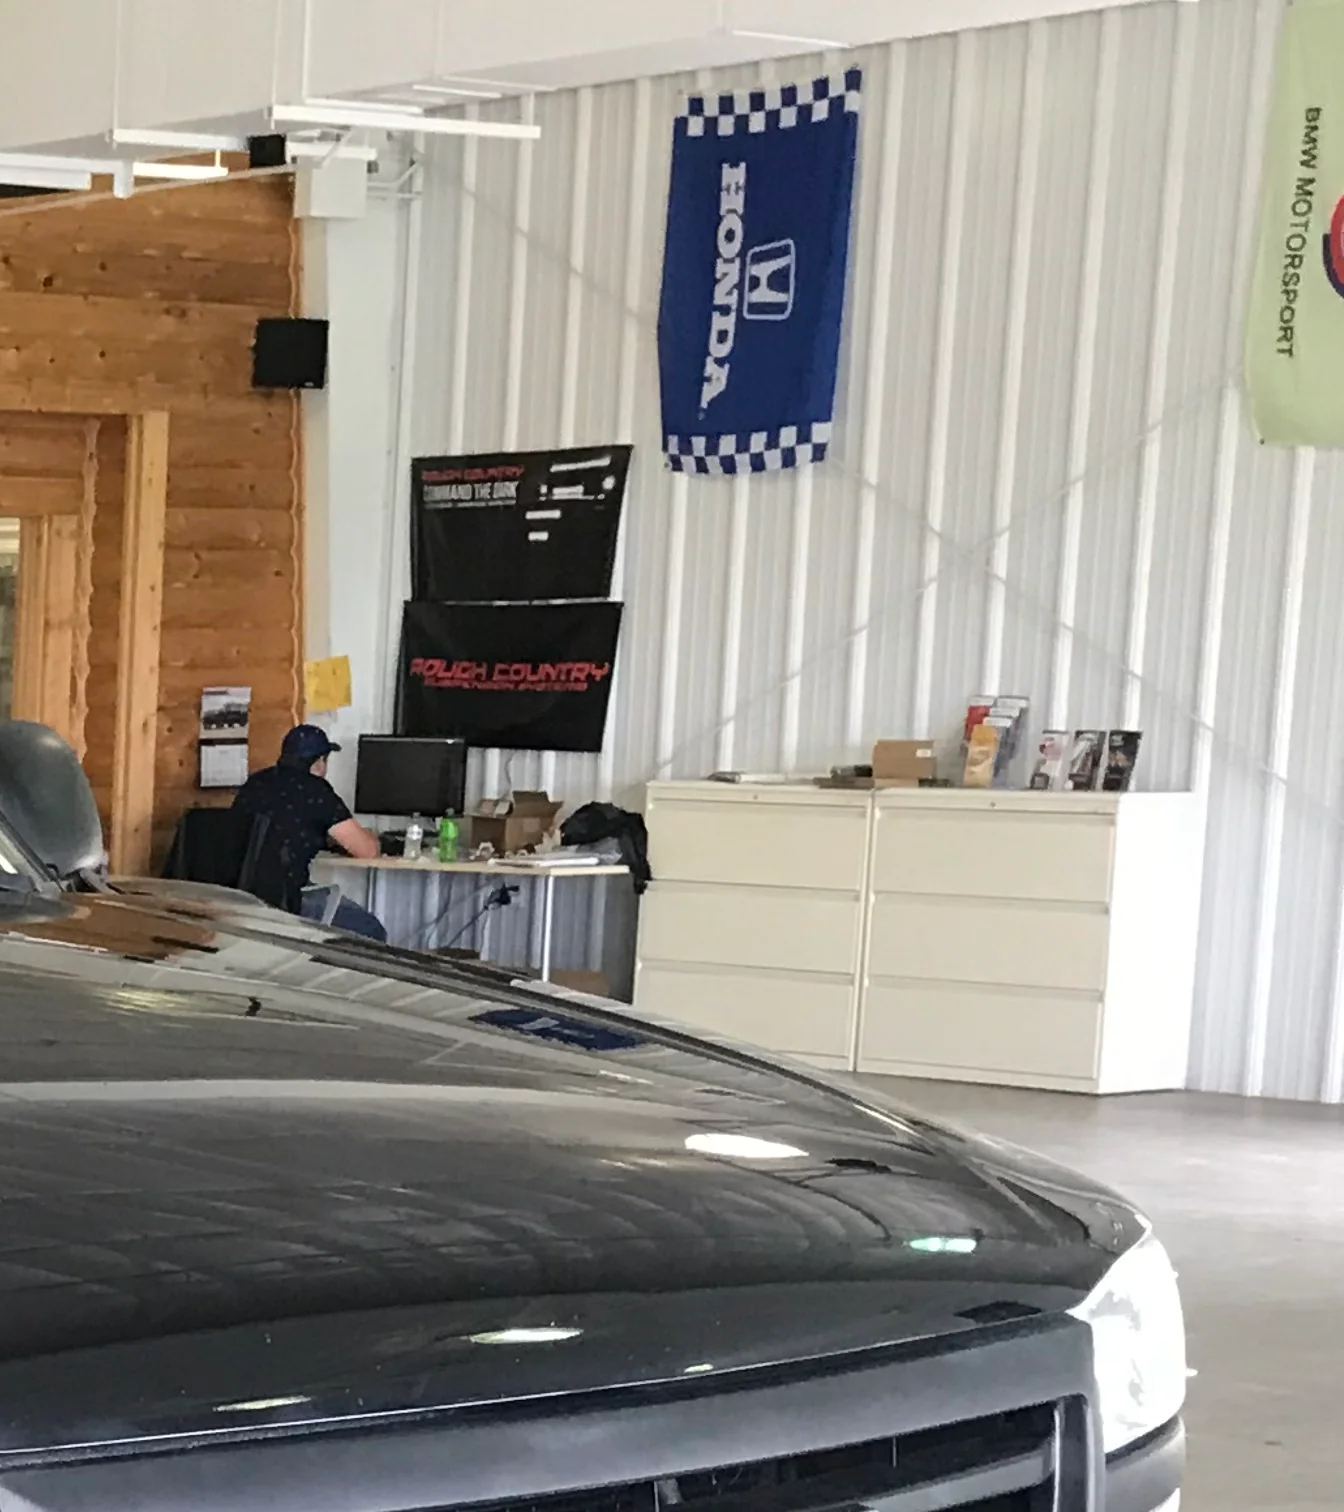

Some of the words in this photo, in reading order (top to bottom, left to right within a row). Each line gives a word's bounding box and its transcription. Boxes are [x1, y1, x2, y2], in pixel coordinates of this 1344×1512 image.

[1299, 107, 1323, 169] BMW
[700, 161, 746, 409] HONDA
[1276, 176, 1317, 358] MOTORSPORT
[410, 657, 487, 680] ROUGH
[493, 660, 610, 682] COUNTRY
